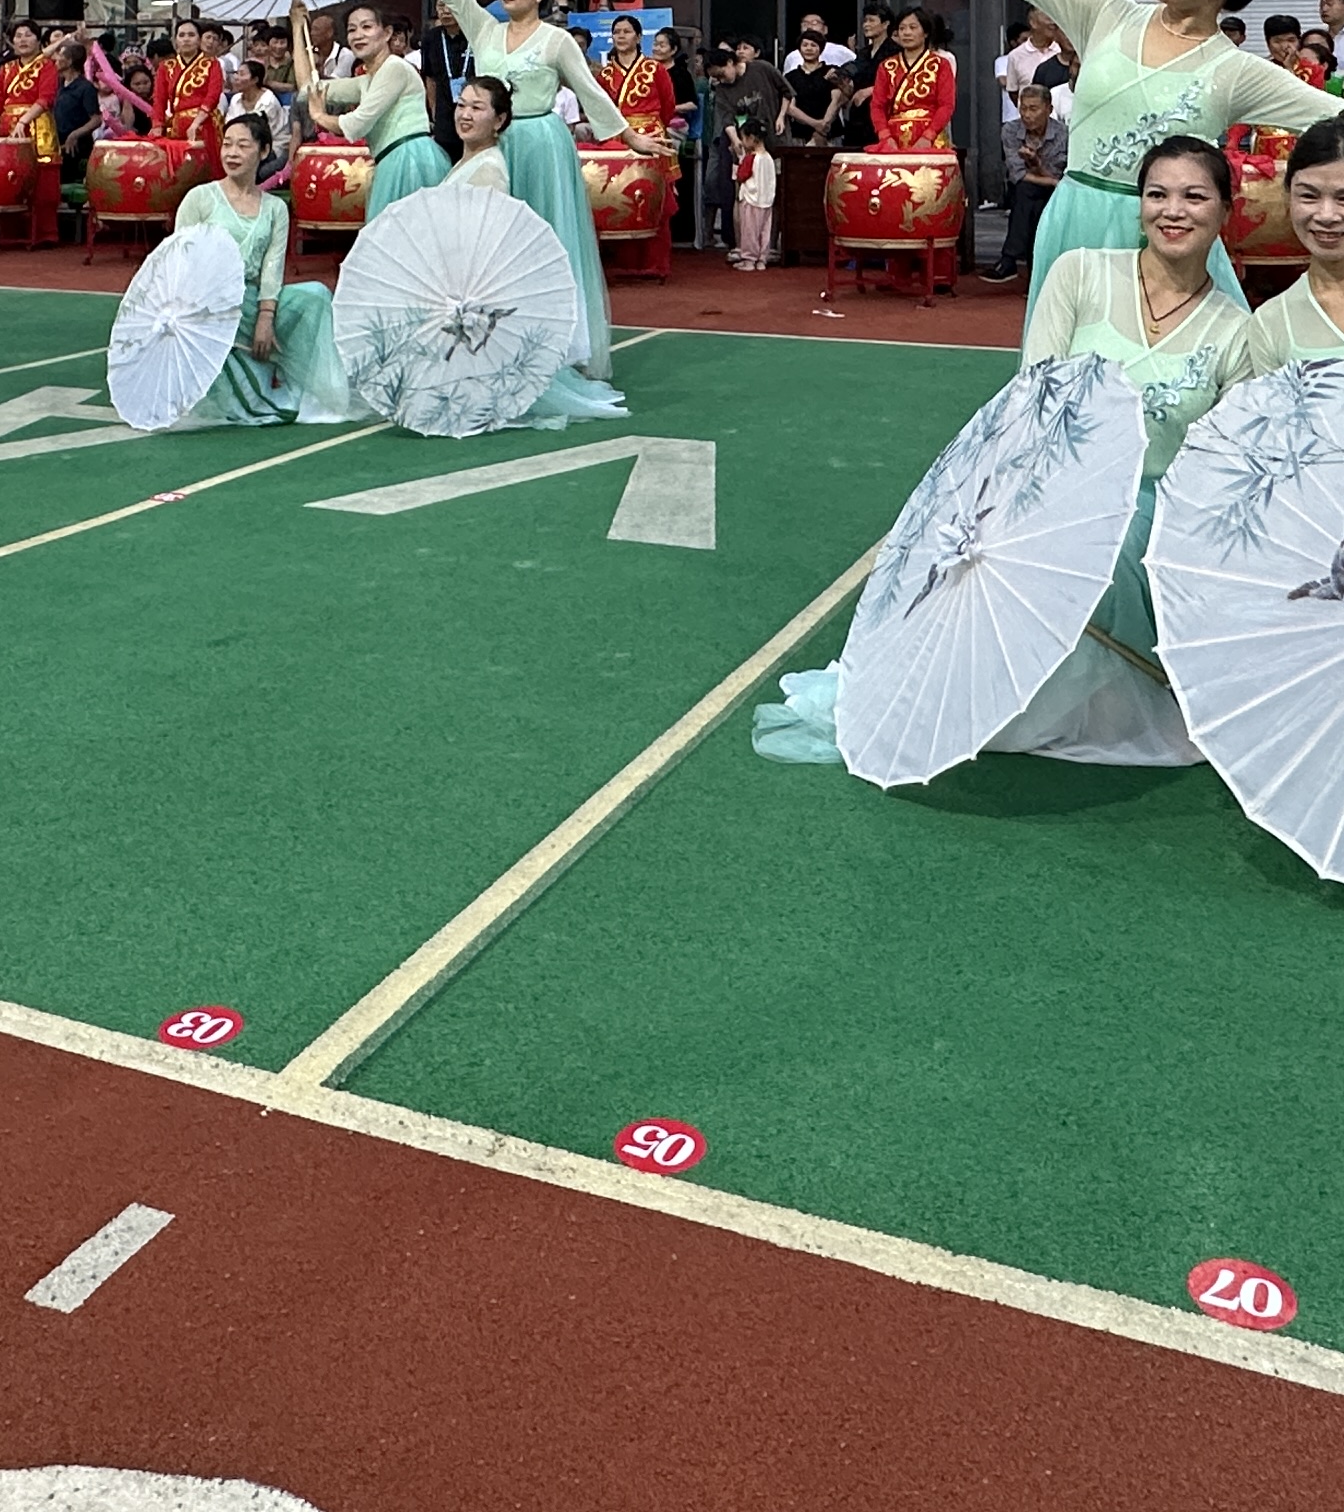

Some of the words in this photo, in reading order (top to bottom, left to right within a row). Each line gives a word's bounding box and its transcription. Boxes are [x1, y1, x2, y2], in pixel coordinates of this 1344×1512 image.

[166, 1011, 234, 1044] 03
[620, 1125, 696, 1167] 05
[1198, 1268, 1283, 1318] 07
